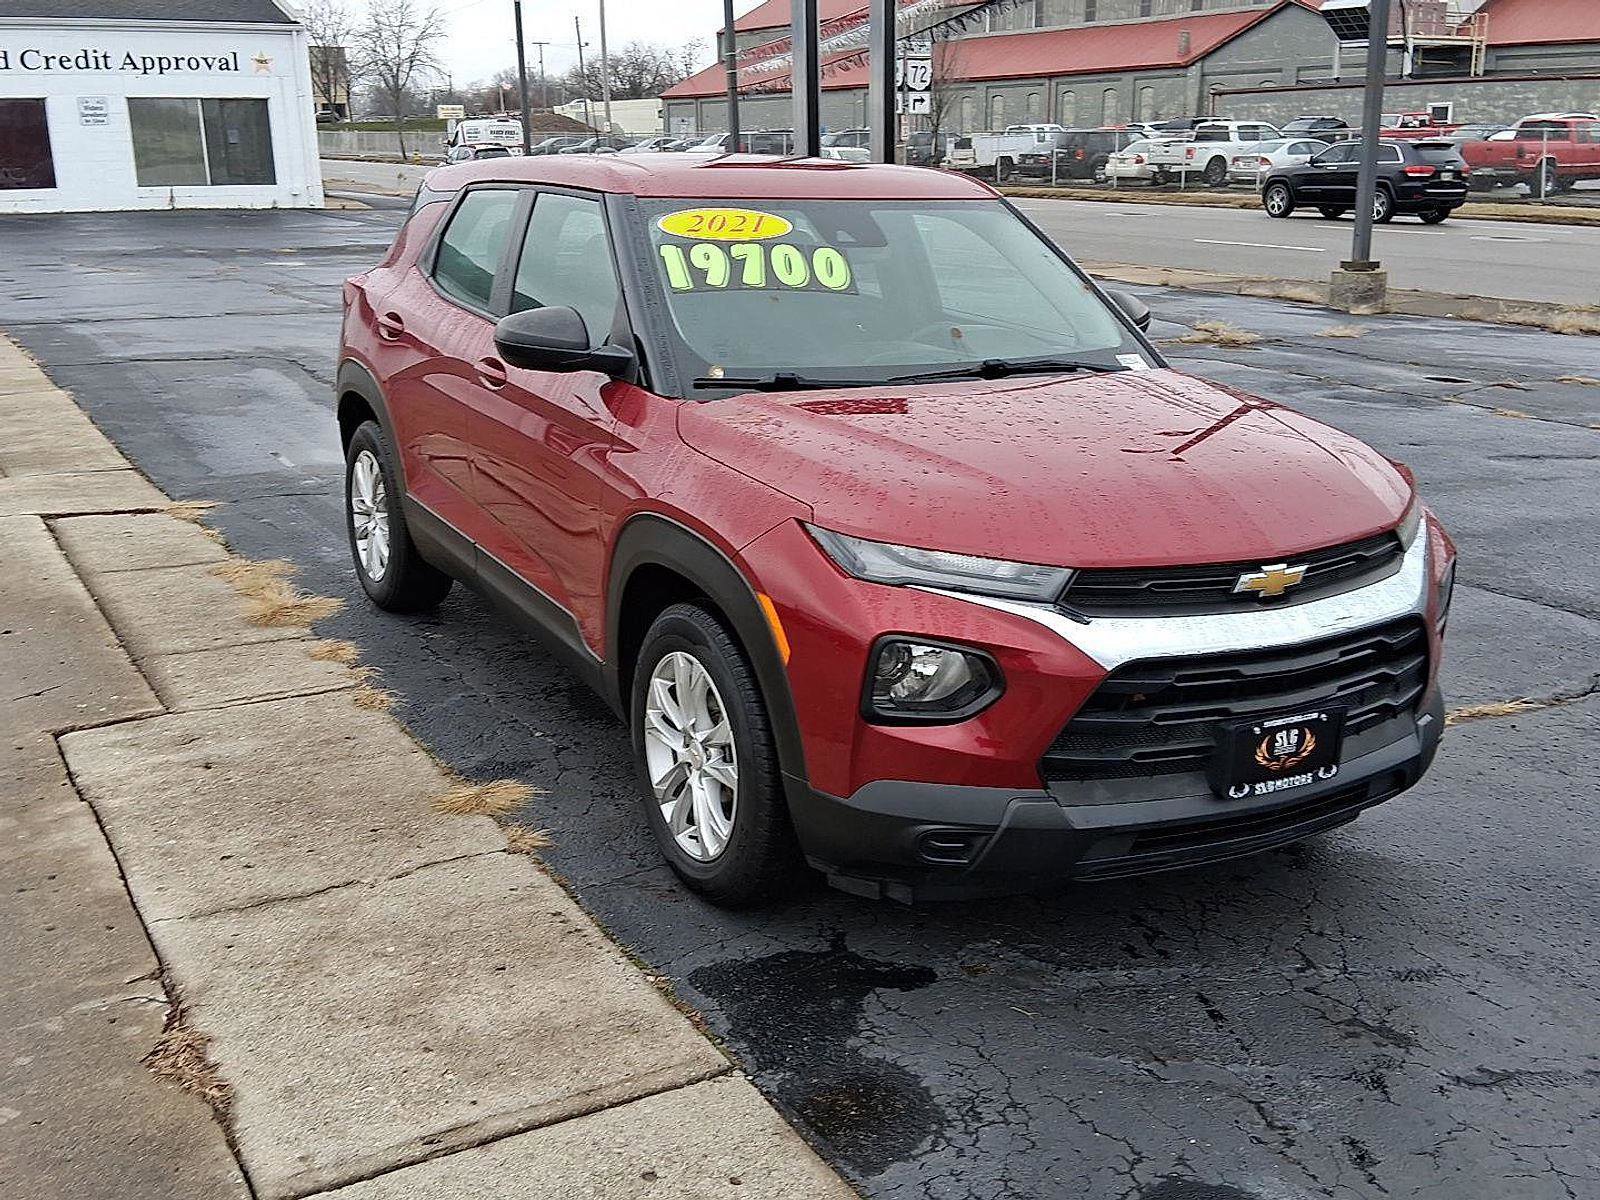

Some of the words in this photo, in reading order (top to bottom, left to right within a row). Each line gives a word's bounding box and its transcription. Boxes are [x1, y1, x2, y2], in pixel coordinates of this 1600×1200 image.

[20, 48, 113, 70] Credit
[119, 51, 240, 75] Approval
[910, 65, 927, 84] 72
[686, 214, 766, 233] 2021
[659, 243, 853, 292] 19700
[1274, 728, 1299, 748] SLG
